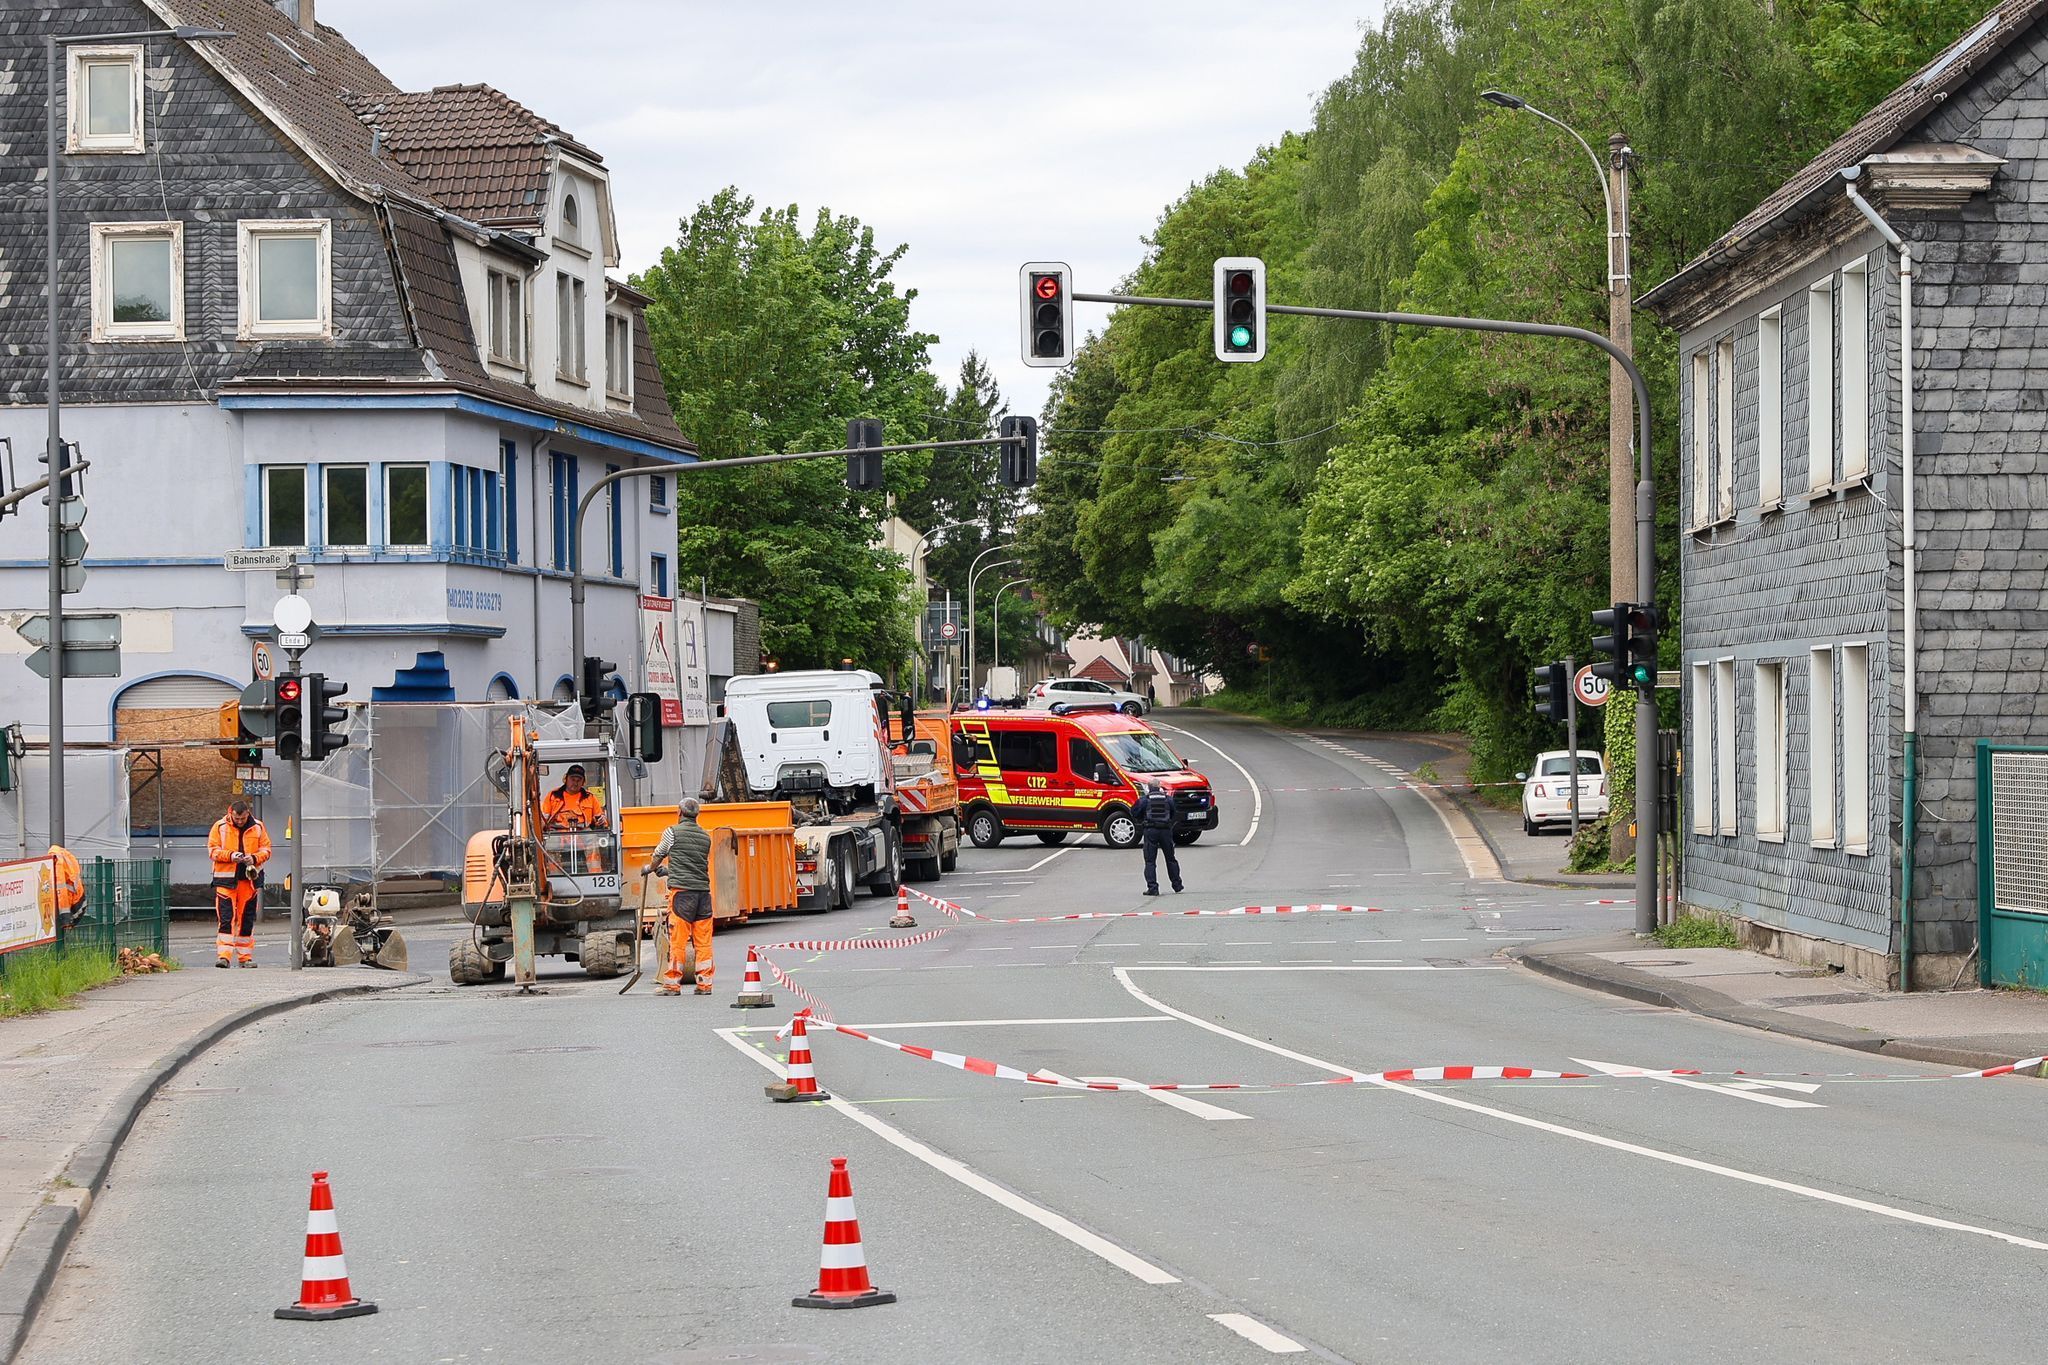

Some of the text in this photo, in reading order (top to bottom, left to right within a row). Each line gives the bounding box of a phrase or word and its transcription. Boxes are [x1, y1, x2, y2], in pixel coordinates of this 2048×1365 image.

[233, 554, 281, 565] Bahnstraße
[476, 591, 502, 611] 8936279
[257, 653, 269, 671] 50
[1583, 676, 1606, 694] 50
[1031, 776, 1047, 788] 112
[1015, 796, 1062, 806] FEUERWEHR
[592, 876, 616, 888] 128
